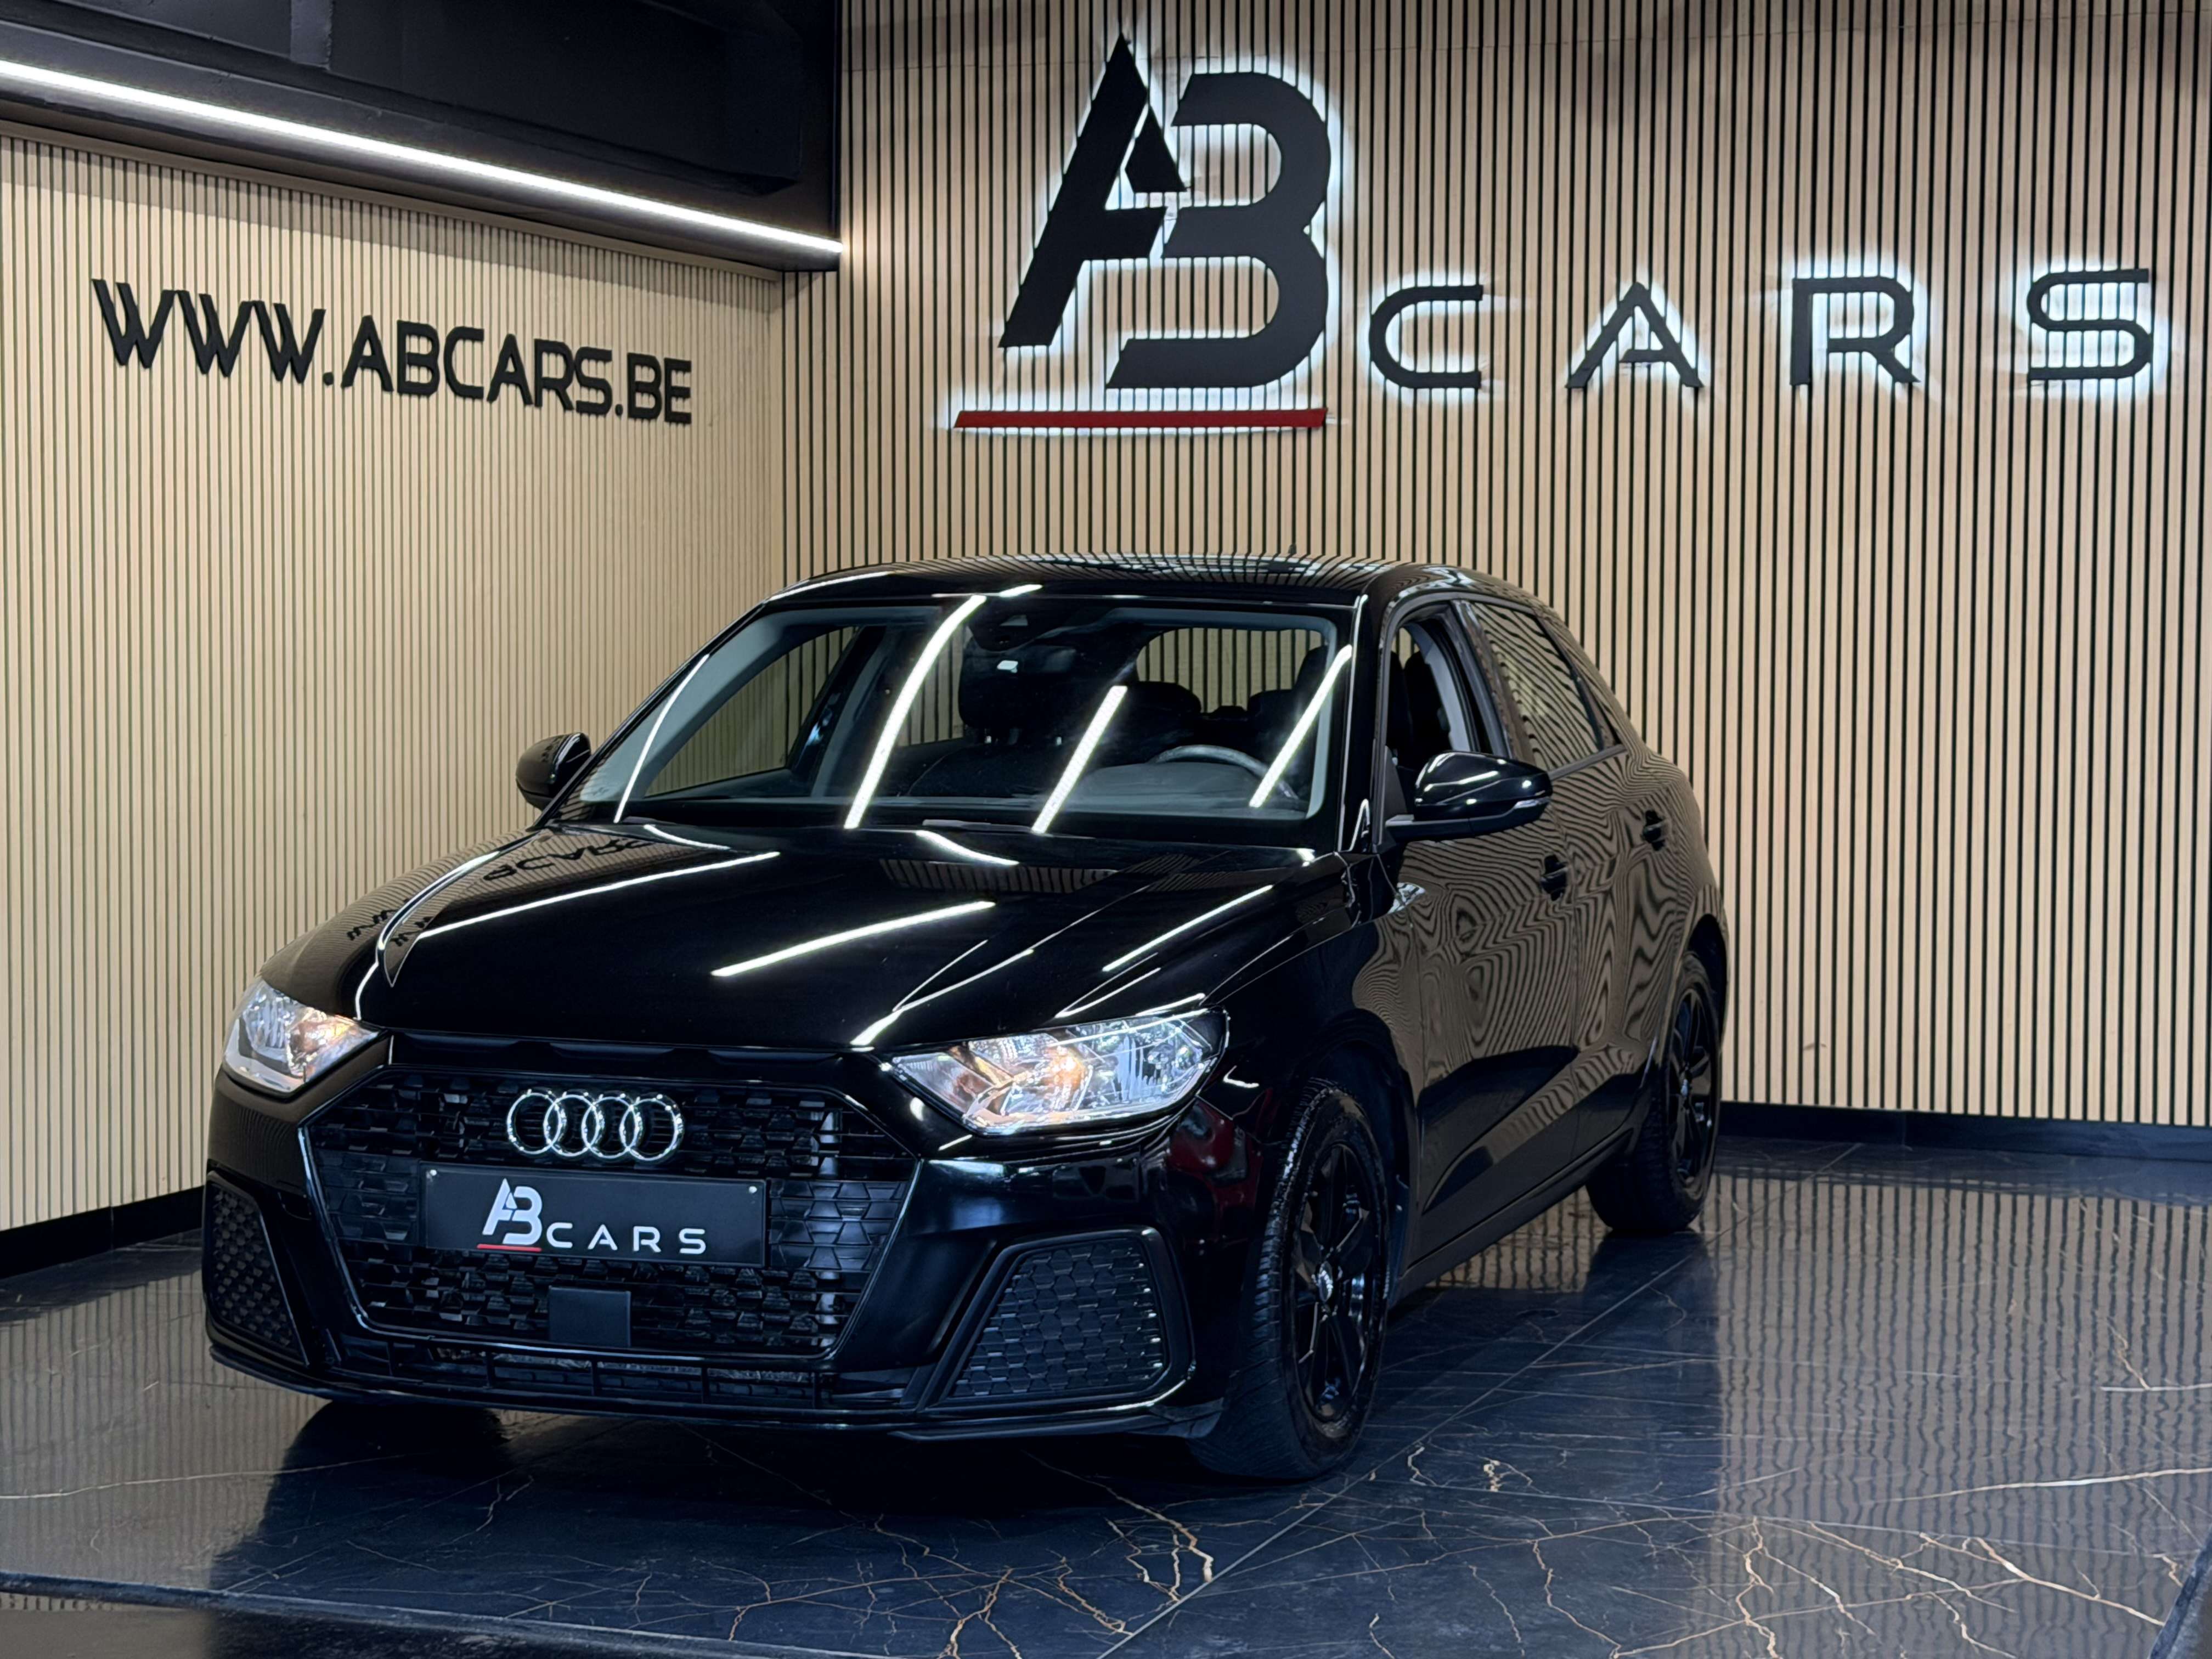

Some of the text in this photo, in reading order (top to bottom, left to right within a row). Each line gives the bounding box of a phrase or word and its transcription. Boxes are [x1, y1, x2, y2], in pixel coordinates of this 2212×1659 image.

[998, 31, 2153, 390] AB CARS
[91, 279, 692, 425] WWW.ABCARS.BE
[482, 1178, 707, 1255] AB CARS
